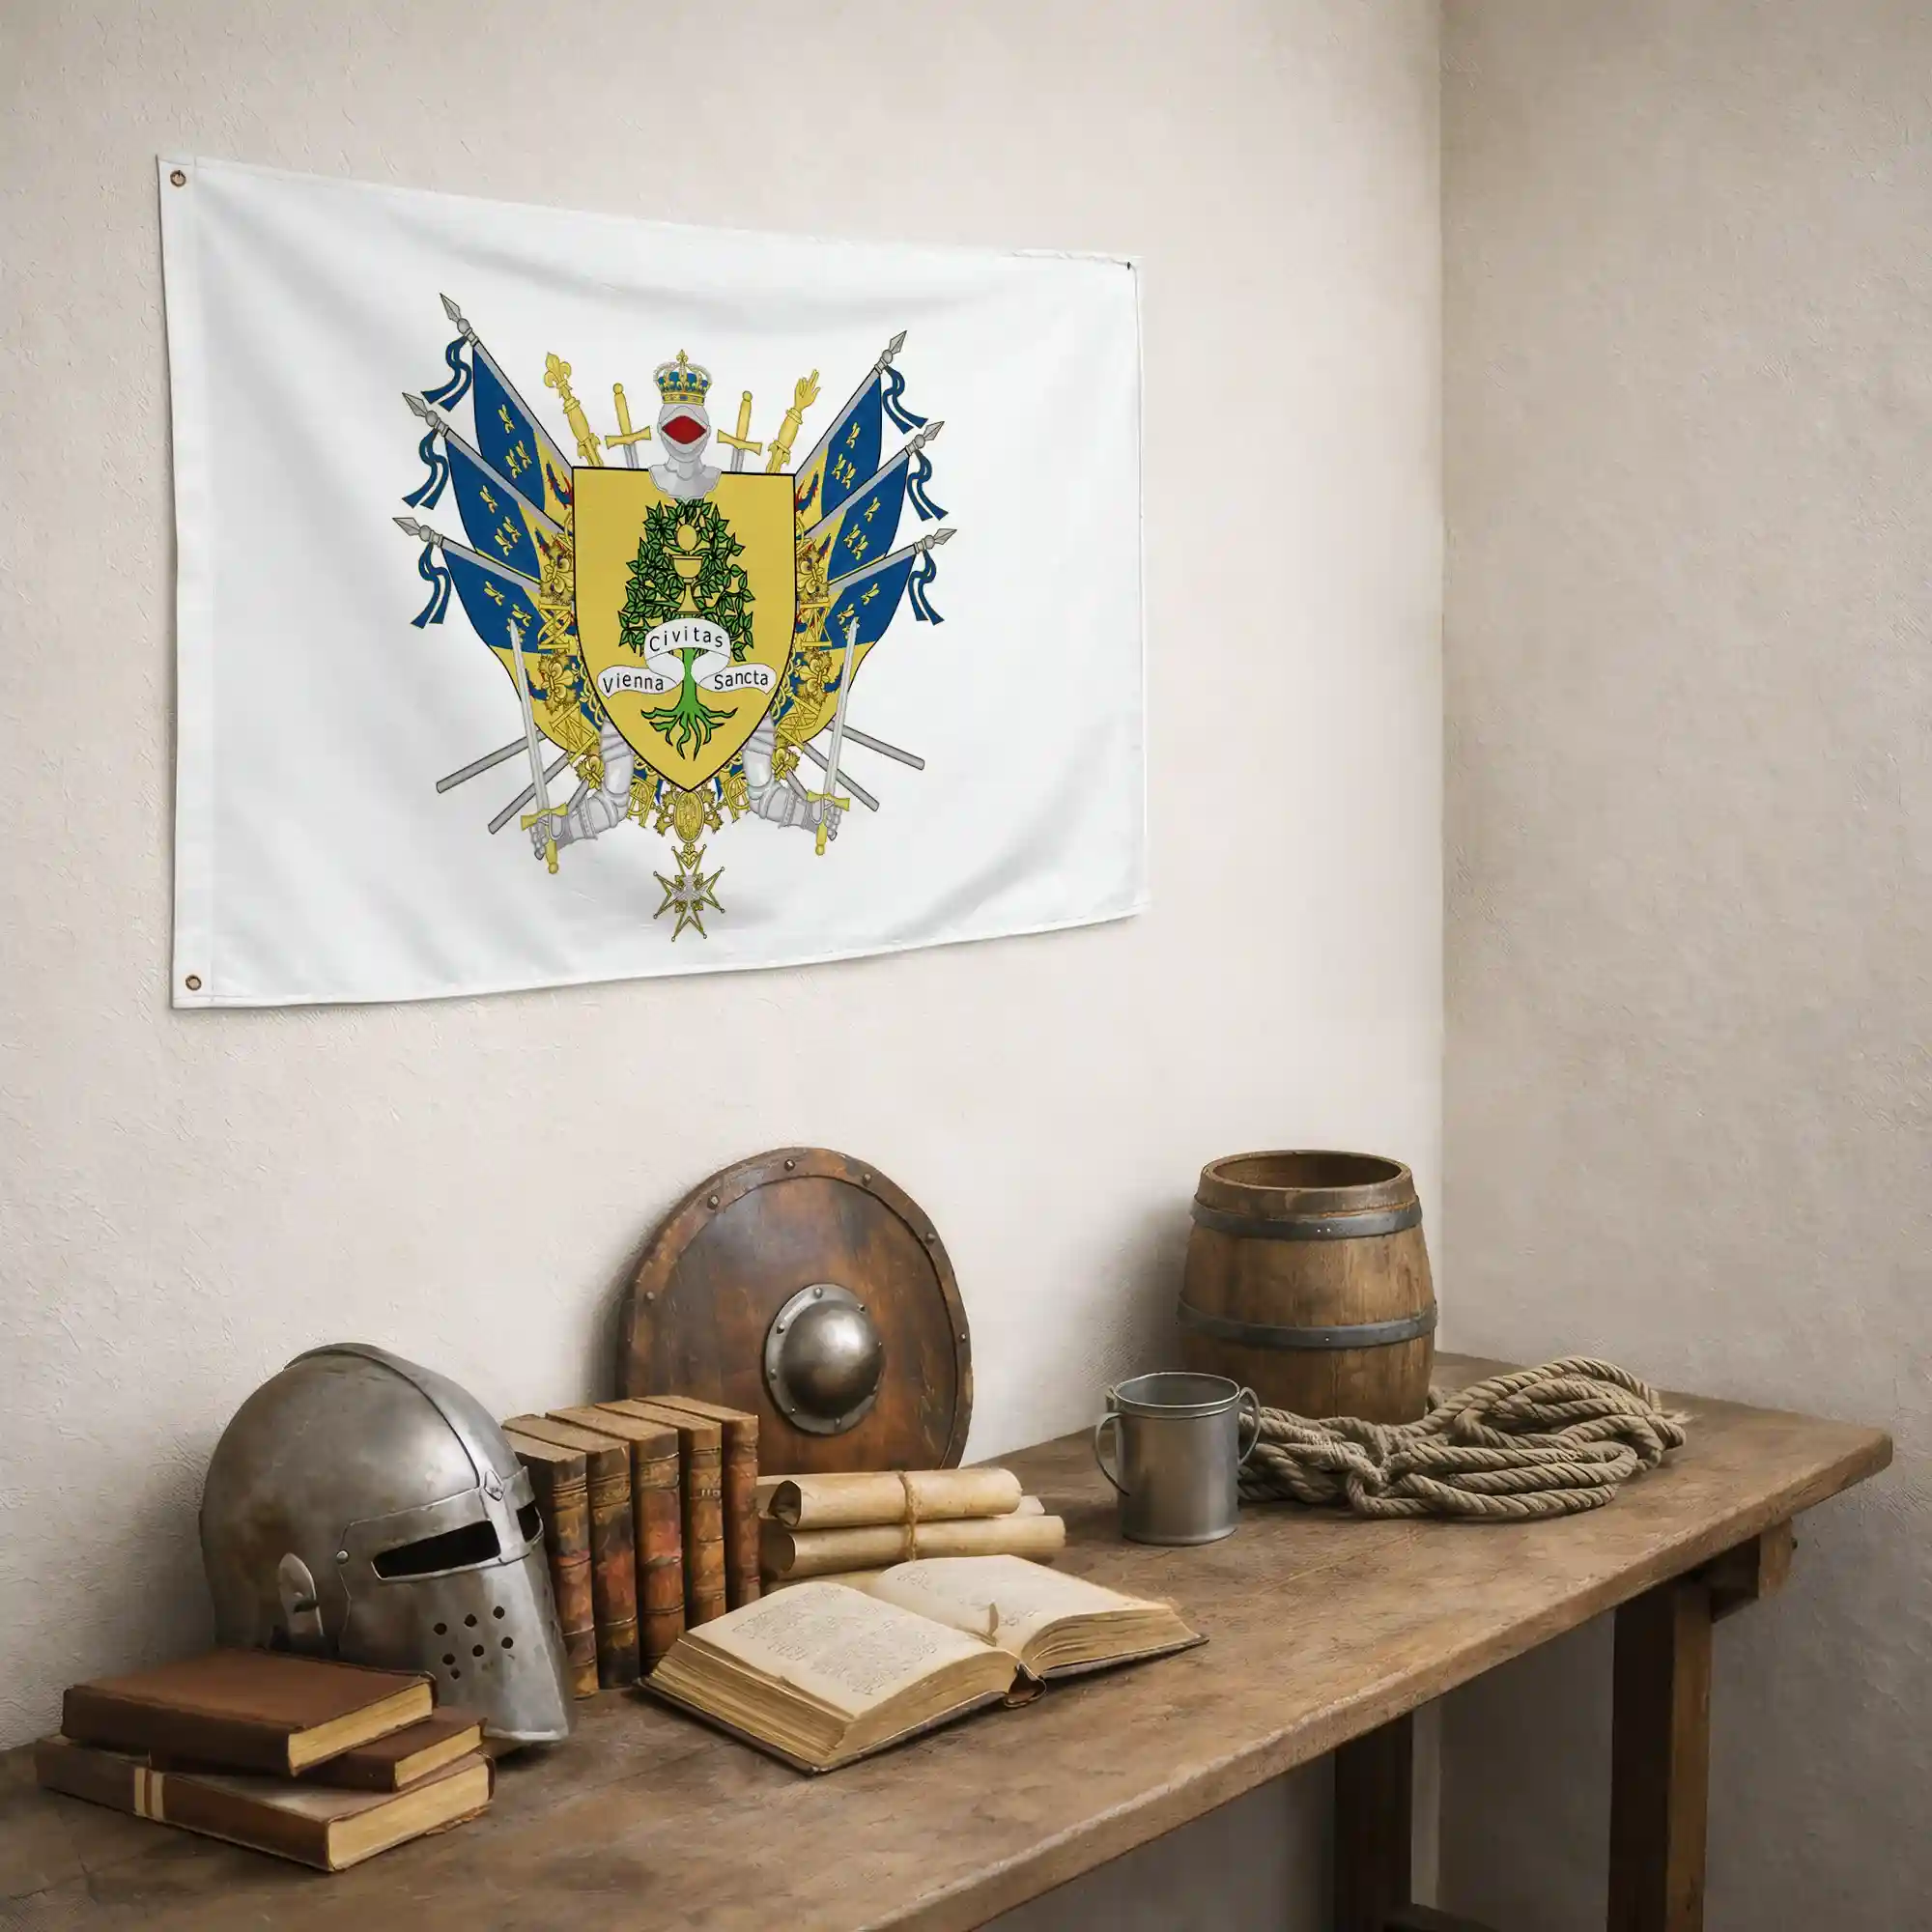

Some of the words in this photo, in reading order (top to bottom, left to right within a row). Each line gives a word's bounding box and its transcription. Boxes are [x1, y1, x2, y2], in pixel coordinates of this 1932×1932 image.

[649, 626, 723, 651] Civitas
[603, 672, 664, 694] Vienna
[714, 669, 769, 690] Sancta
